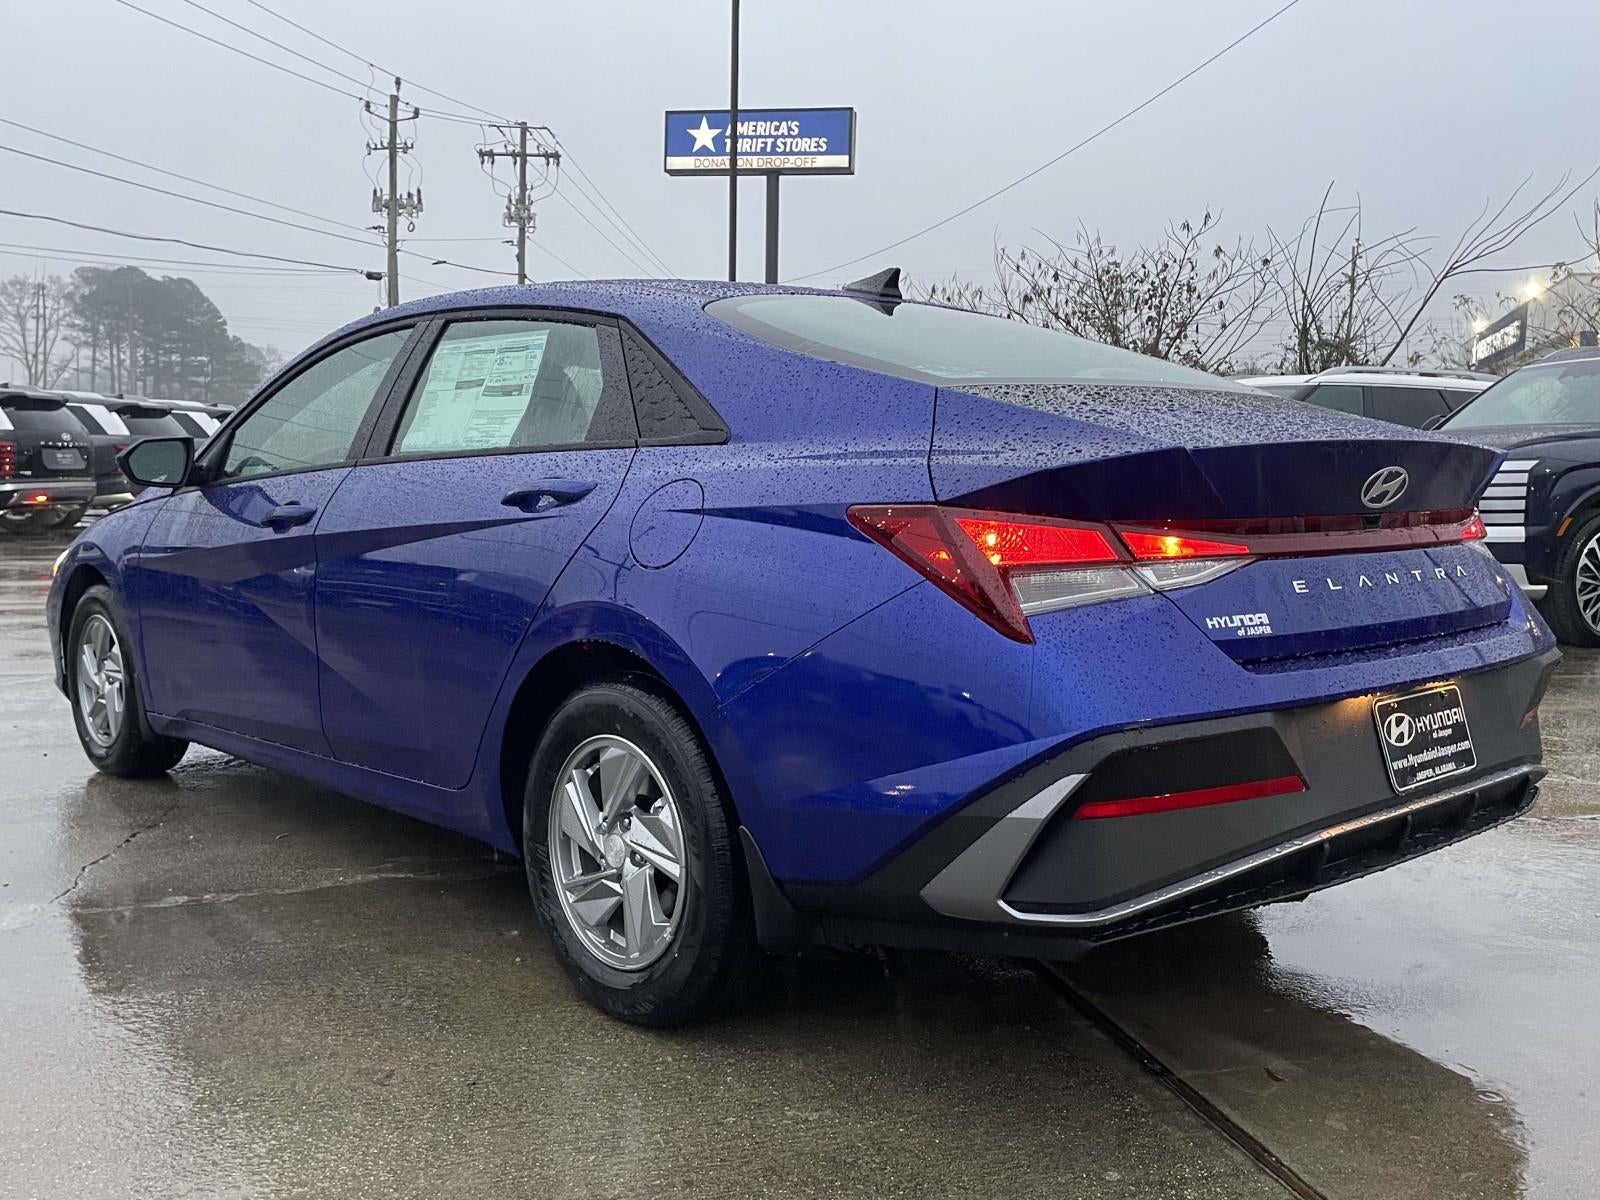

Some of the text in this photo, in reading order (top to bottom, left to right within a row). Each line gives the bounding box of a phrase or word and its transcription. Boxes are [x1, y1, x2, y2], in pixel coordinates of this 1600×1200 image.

[776, 137, 828, 152] STORES
[694, 157, 818, 168] DONAON DROP-OFF
[1292, 566, 1468, 594] ELANTRA
[1206, 612, 1270, 629] HYUNDAI
[1237, 625, 1273, 636] of JASPER
[1415, 707, 1464, 733] HYUNDAI
